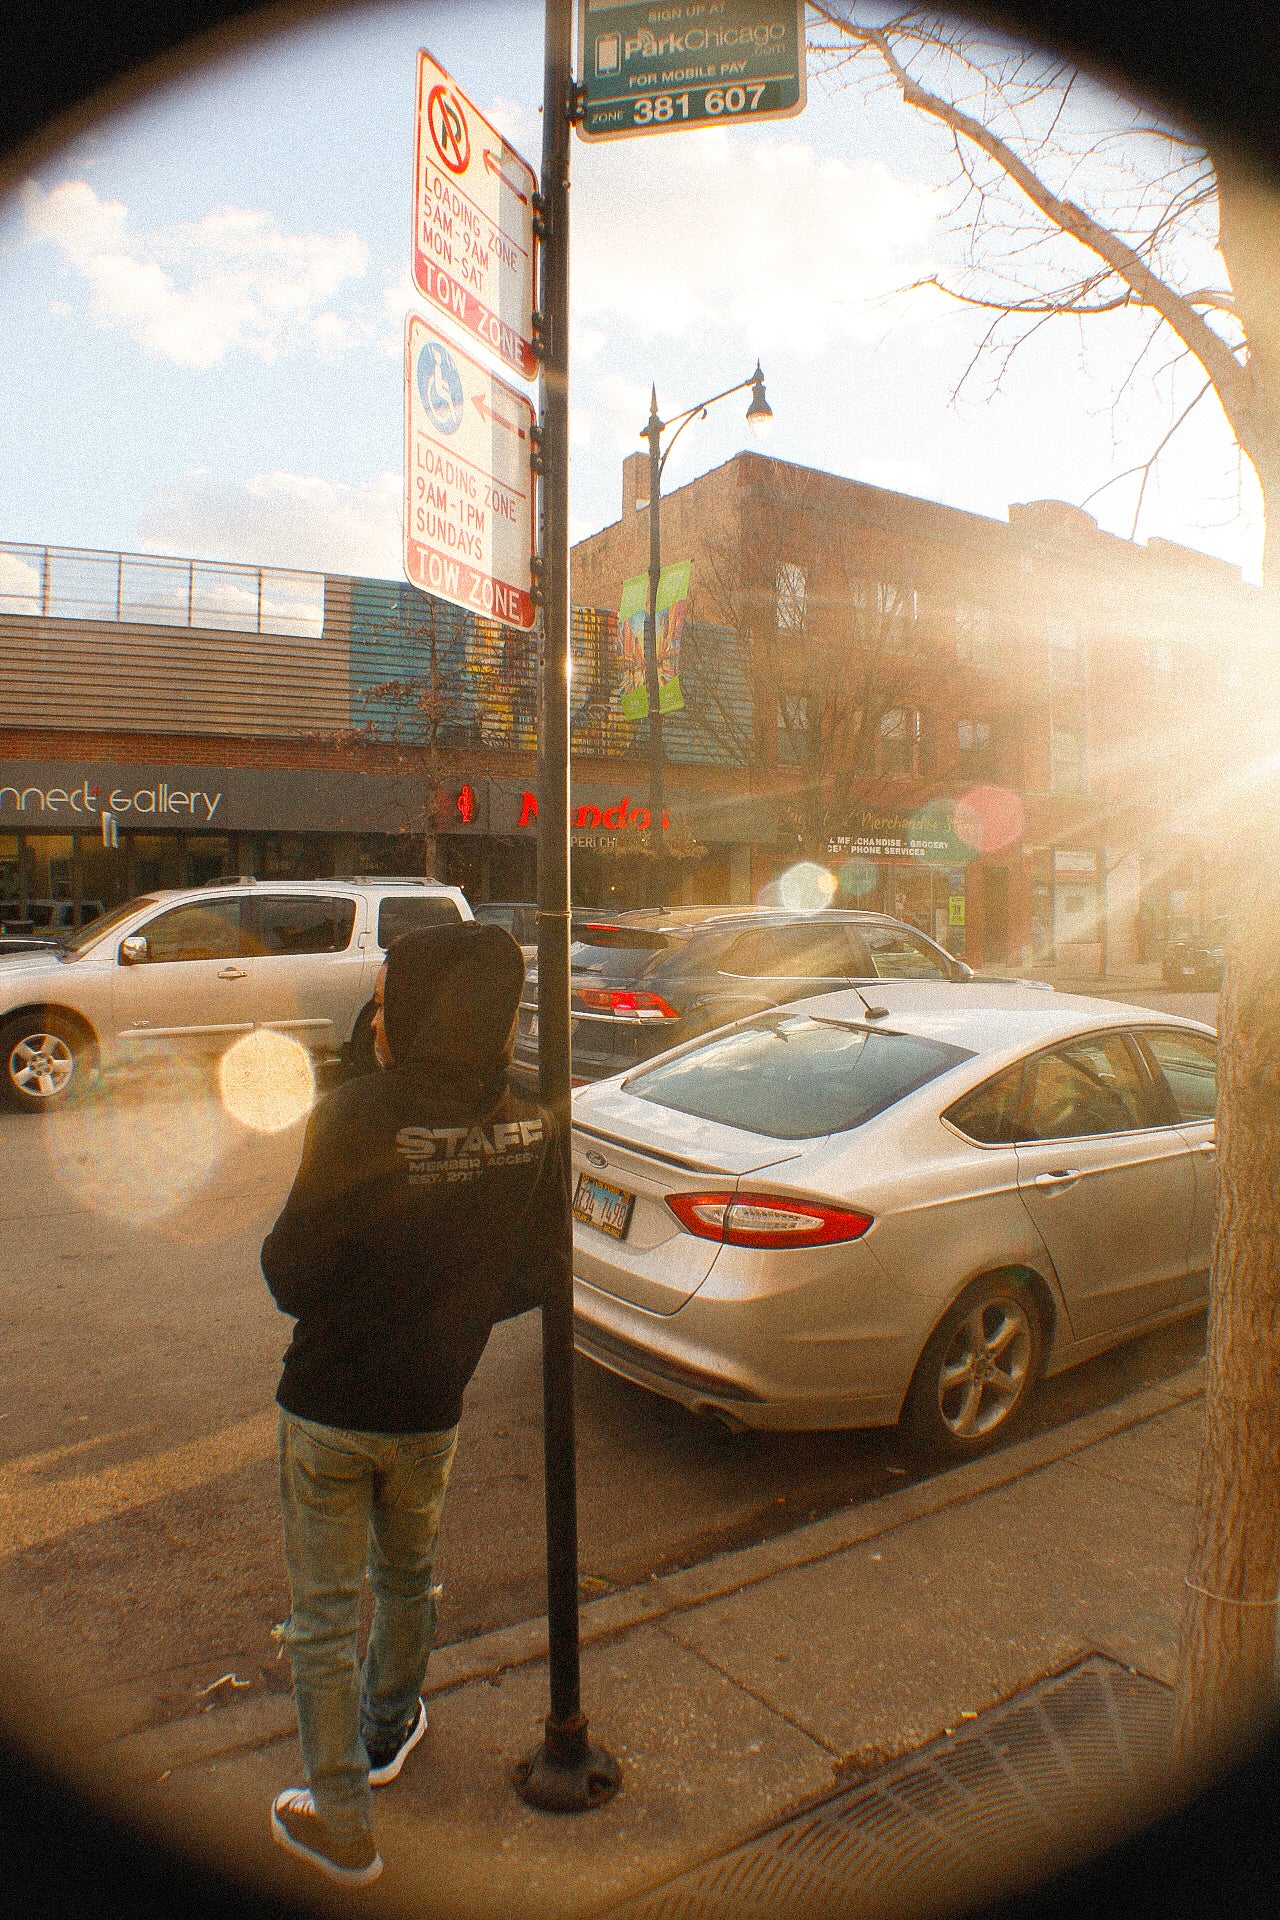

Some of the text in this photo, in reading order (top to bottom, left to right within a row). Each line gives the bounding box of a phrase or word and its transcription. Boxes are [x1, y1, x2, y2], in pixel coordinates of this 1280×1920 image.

[648, 1, 726, 23] SIGN UP AT
[624, 21, 786, 61] ParkChicago
[751, 44, 786, 57] .com
[629, 59, 748, 88] FOR MOBILE PAY
[591, 82, 767, 125] ZONE 381 607
[424, 167, 518, 273] LOADING ZONE
[423, 259, 525, 369] TOW ZONE
[416, 443, 517, 524] LOADING ZONE
[416, 508, 483, 561] SUNDAYS
[416, 545, 521, 622] TOW ZONE
[850, 846, 881, 856] PHONE
[884, 846, 926, 857] SERVICES
[909, 839, 949, 850] GROCERY
[395, 1118, 544, 1160] STAFF
[408, 1158, 481, 1174] MEMBER
